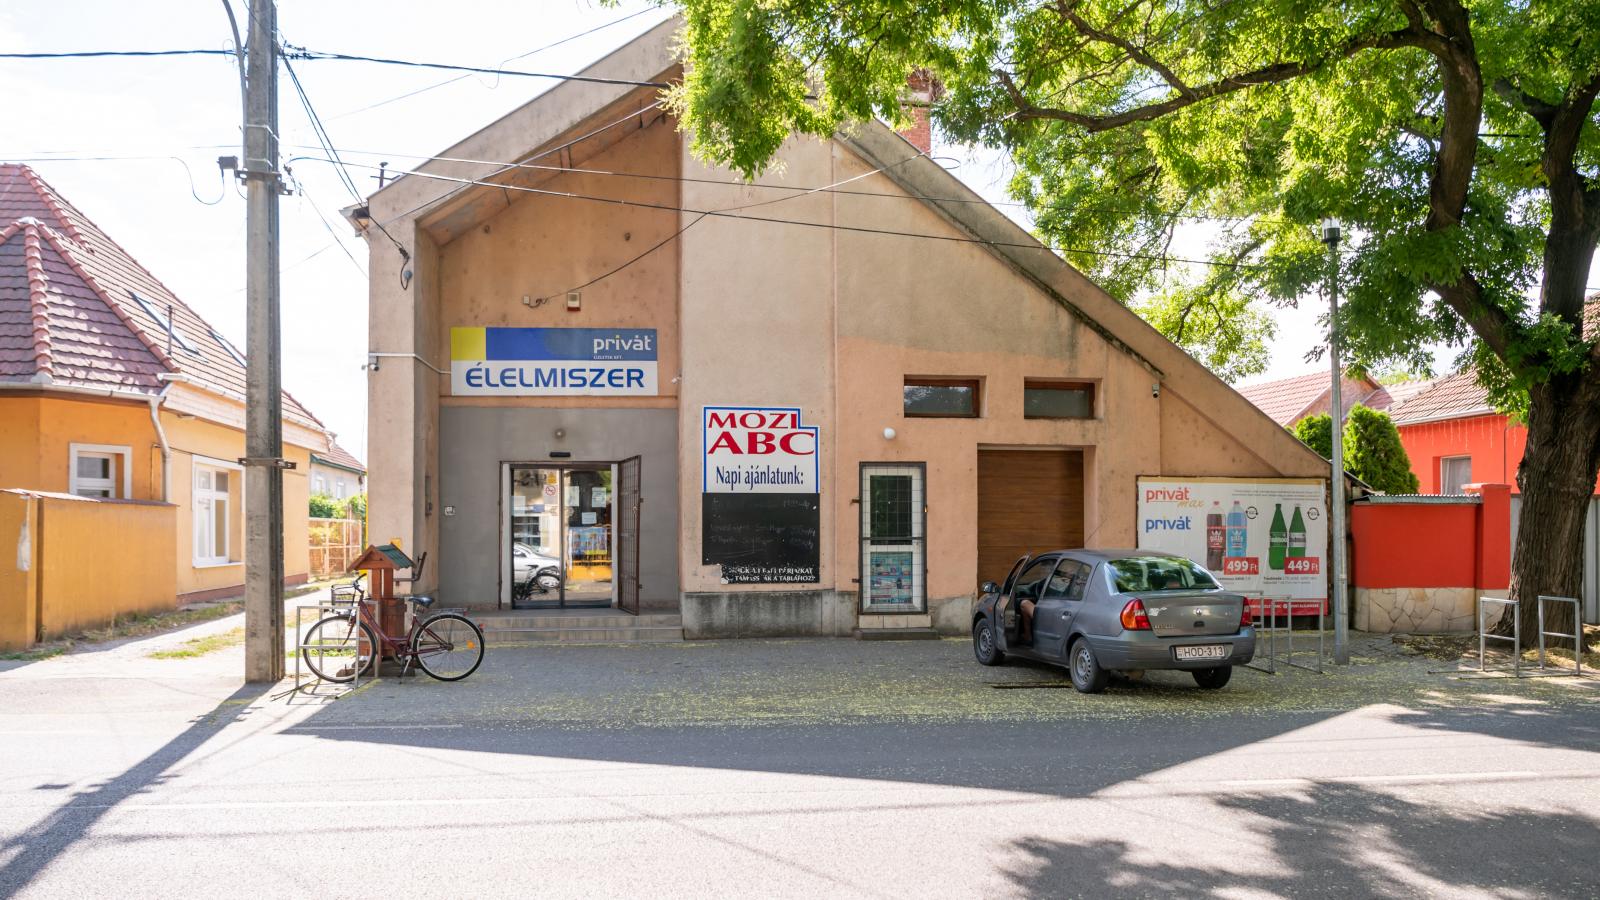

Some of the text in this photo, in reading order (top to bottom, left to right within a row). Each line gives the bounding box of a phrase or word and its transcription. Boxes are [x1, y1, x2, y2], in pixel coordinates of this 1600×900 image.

[593, 335, 652, 353] privát
[465, 362, 644, 388] ÉLELMISZER
[708, 412, 798, 429] MOZI
[707, 431, 815, 456] ABC
[716, 465, 804, 491] Napi ajánlatunk:
[1146, 487, 1190, 503] privát
[1145, 516, 1192, 533] privát
[1227, 560, 1258, 571] 499 Ft
[1287, 560, 1319, 571] 449 Ft
[1184, 646, 1224, 657] HOD-313
